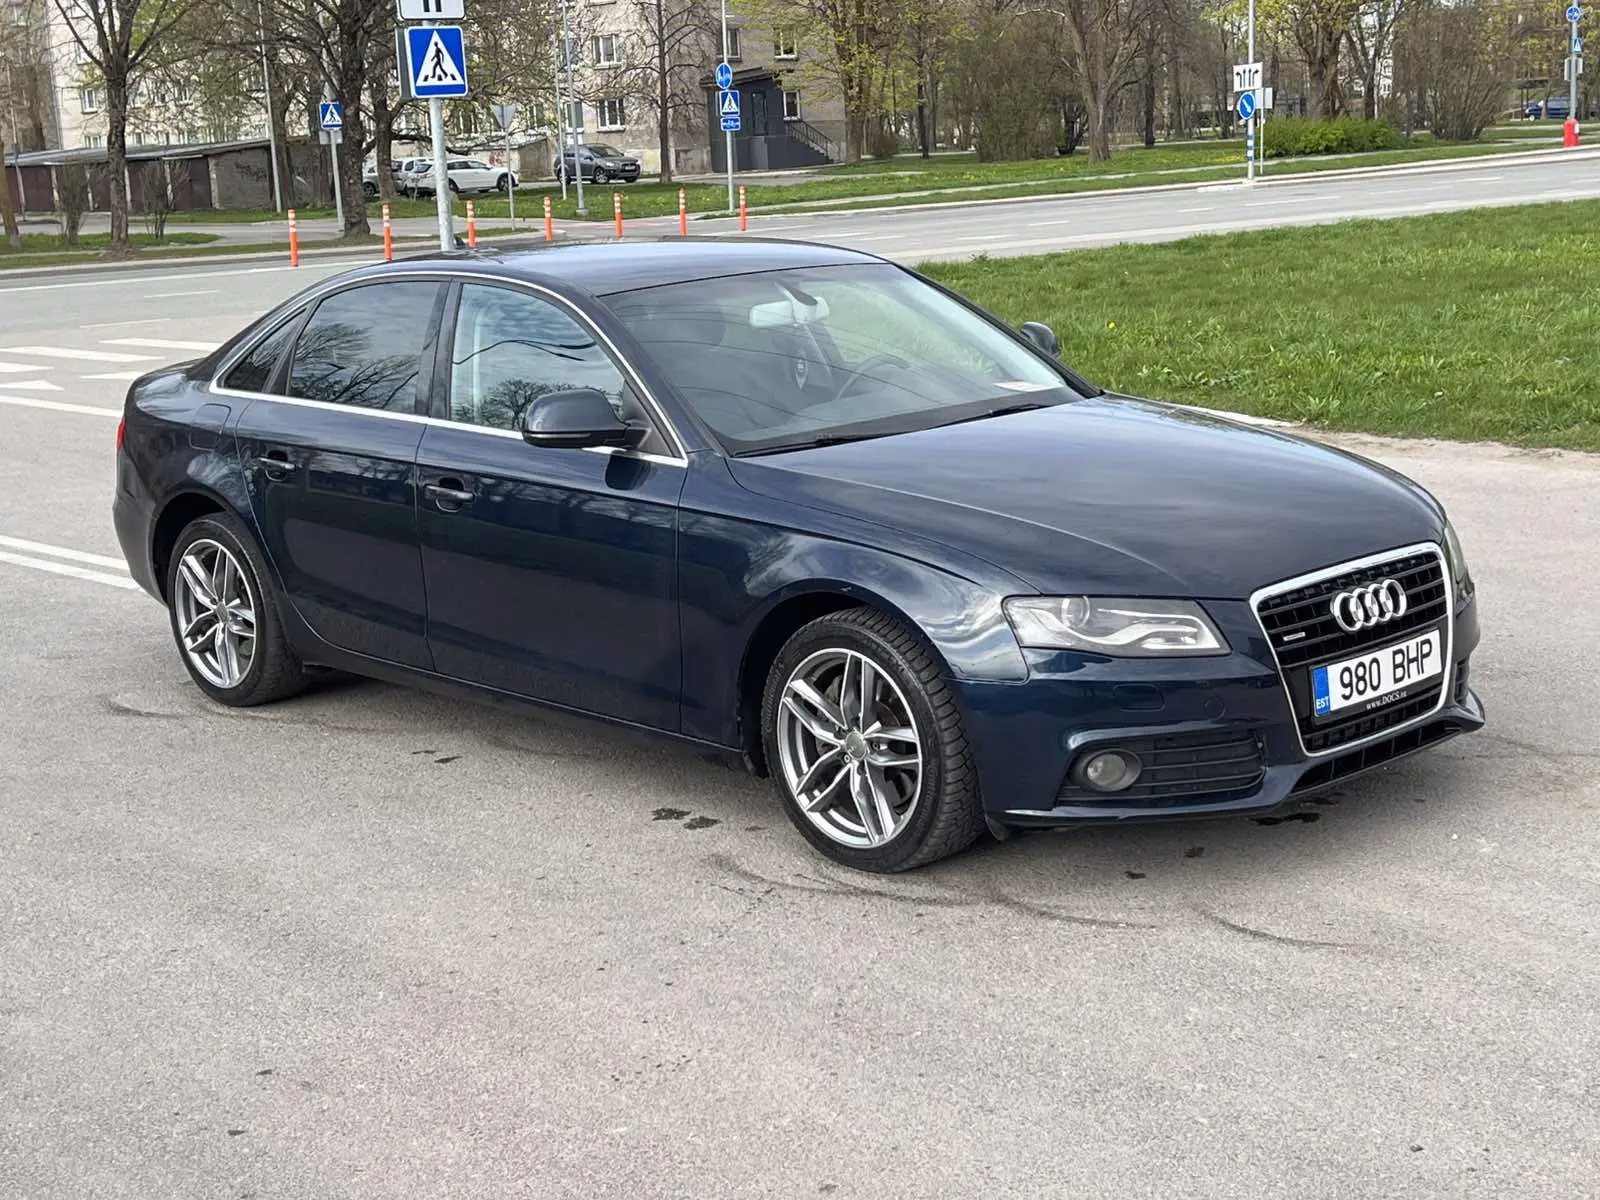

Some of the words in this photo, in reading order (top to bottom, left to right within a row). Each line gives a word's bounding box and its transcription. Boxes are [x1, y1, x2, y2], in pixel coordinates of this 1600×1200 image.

[1340, 657, 1381, 701] 980
[1392, 638, 1432, 684] BHP
[1315, 696, 1329, 709] EST
